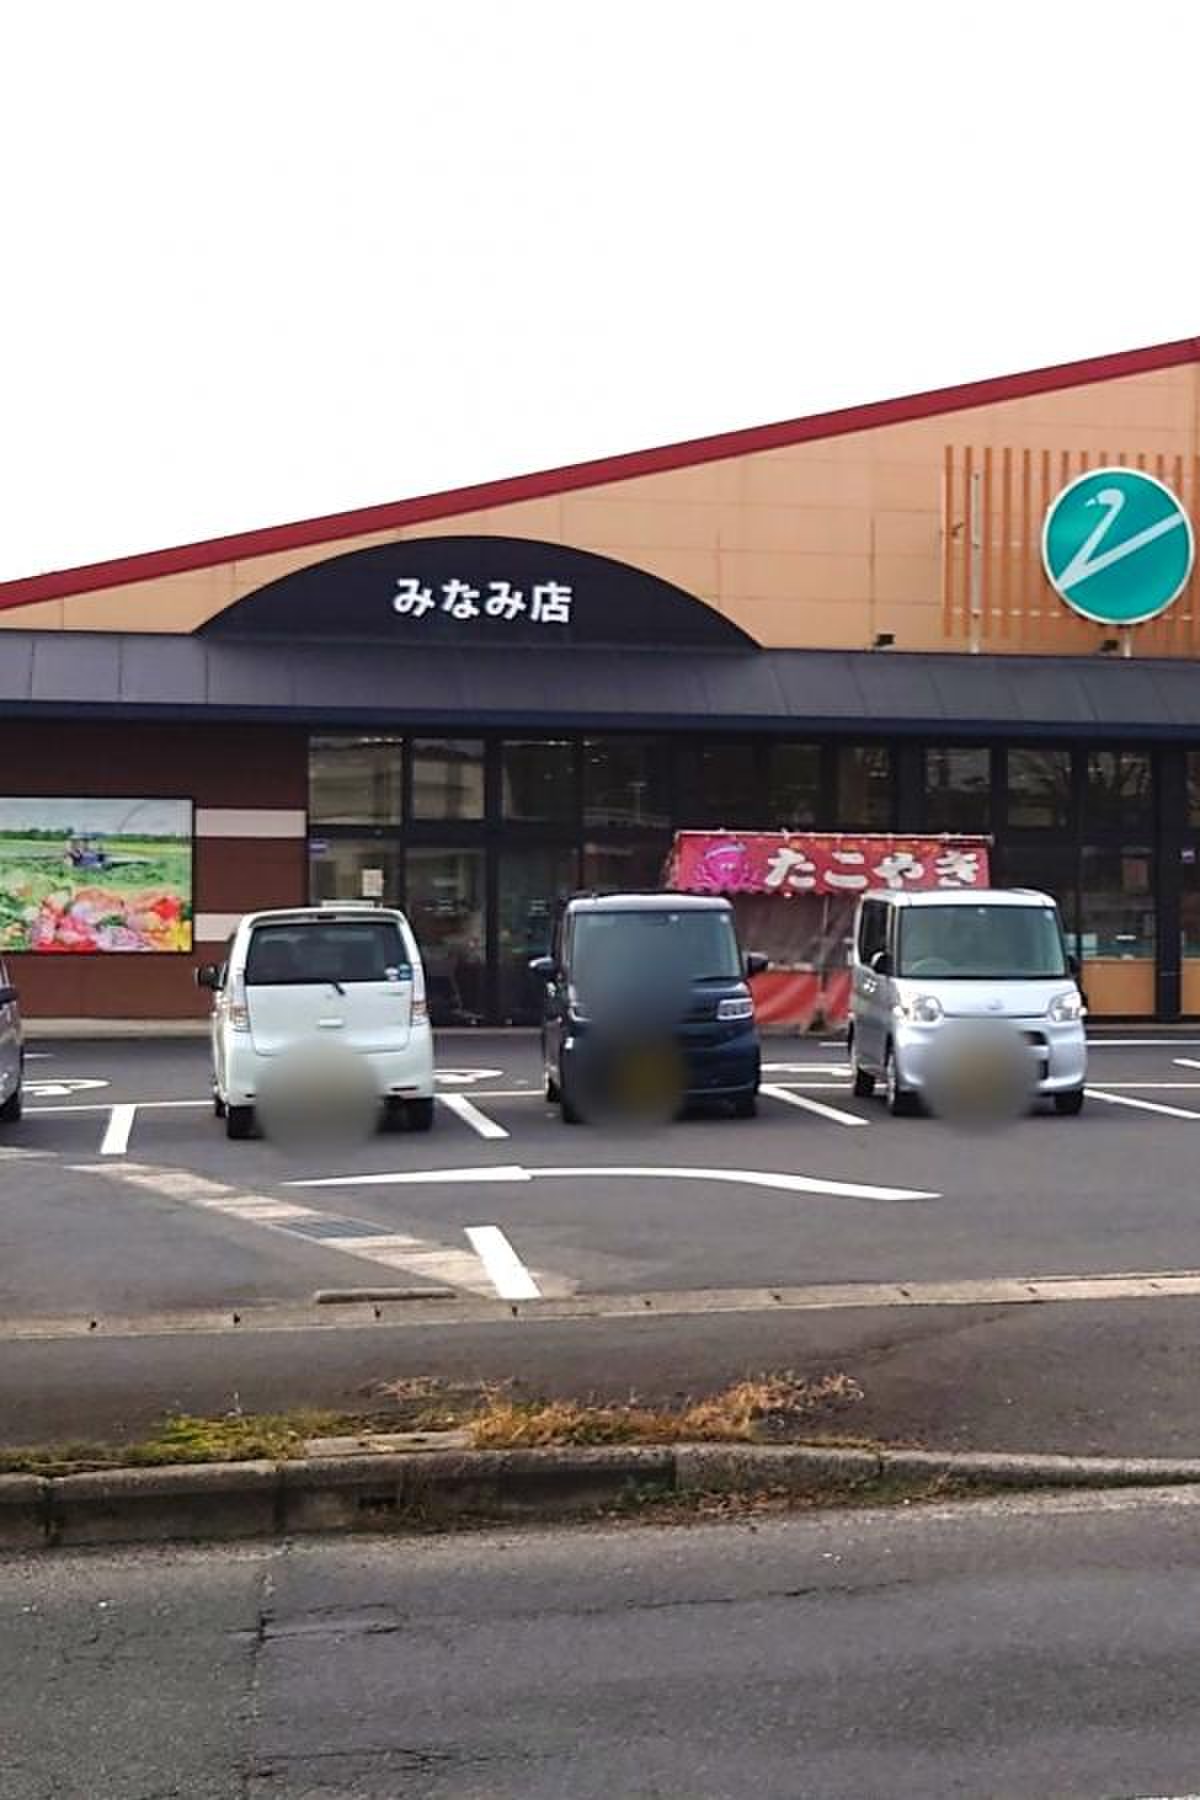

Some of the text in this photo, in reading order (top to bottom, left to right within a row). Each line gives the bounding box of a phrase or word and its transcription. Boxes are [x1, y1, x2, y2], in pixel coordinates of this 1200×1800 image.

[392, 577, 573, 624] みなみ店
[764, 847, 979, 888] たこやき
